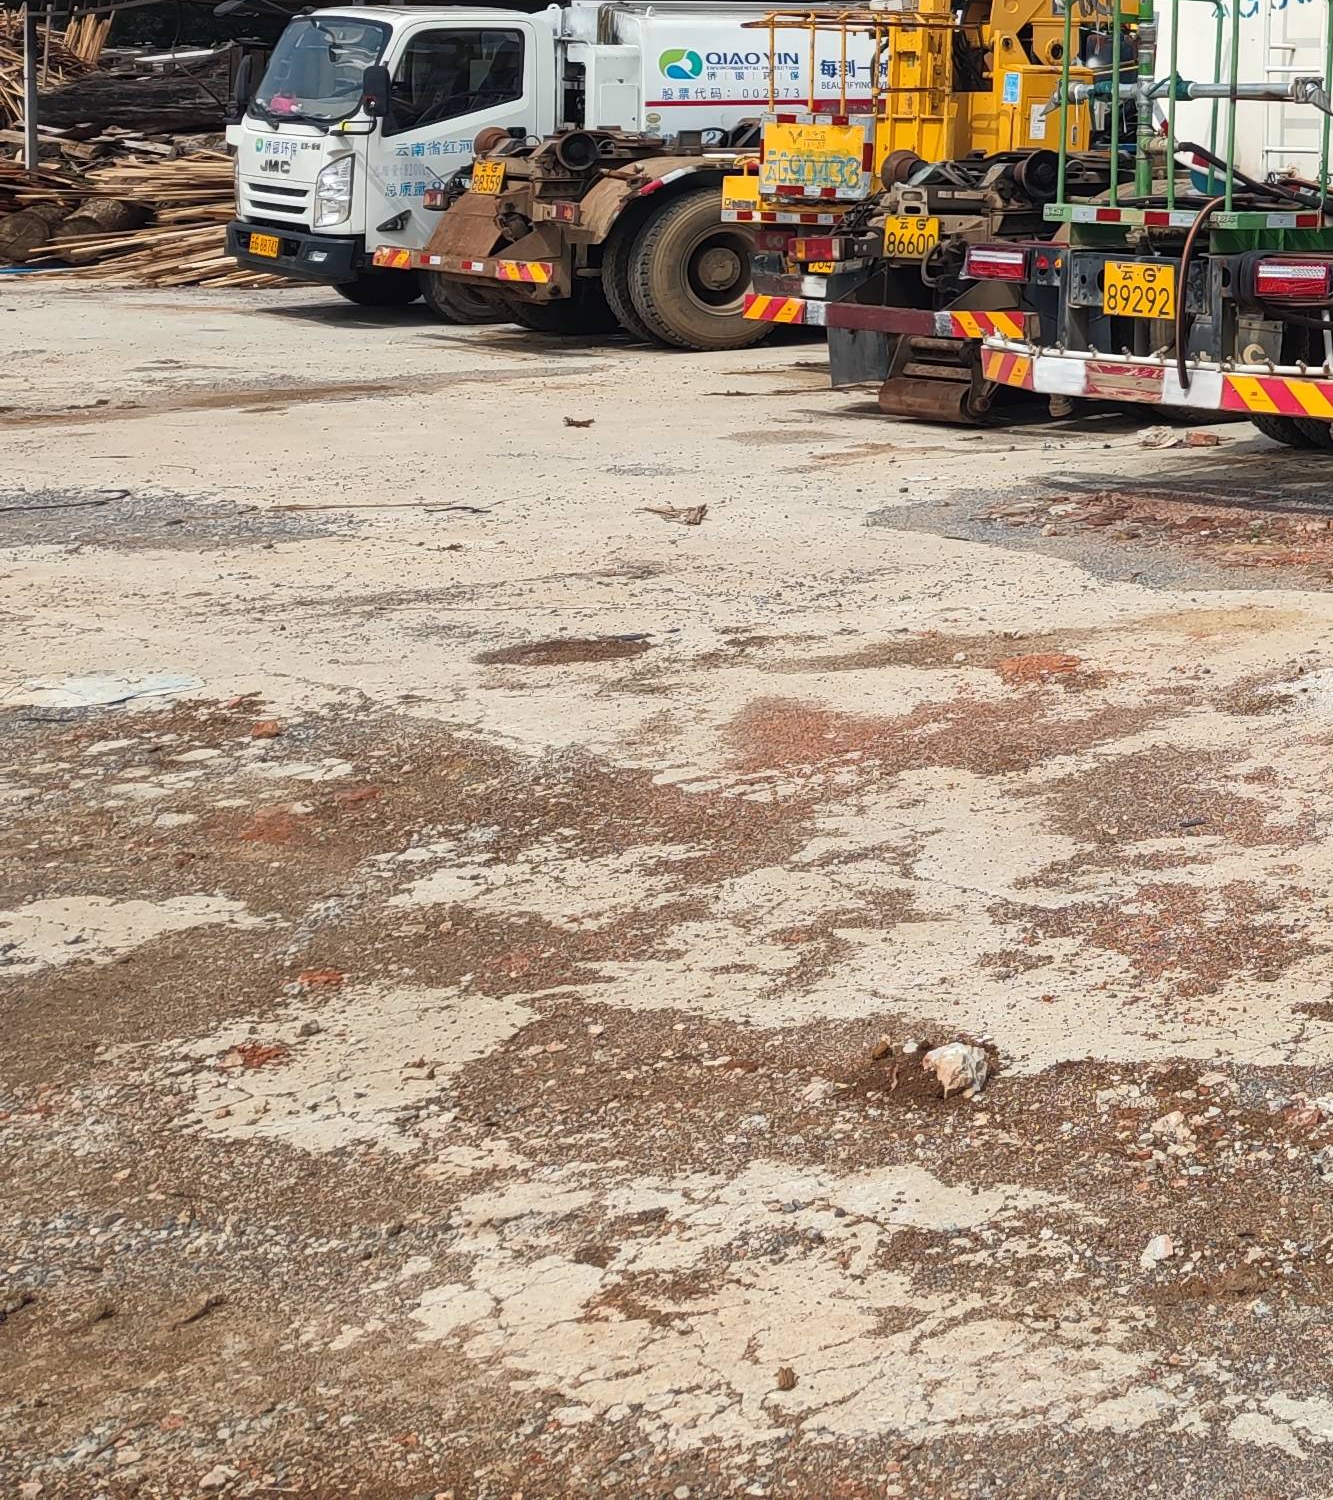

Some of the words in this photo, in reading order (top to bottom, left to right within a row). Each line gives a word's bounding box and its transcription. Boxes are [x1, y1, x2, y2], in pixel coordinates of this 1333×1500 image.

[260, 159, 290, 174] JMC
[887, 232, 935, 254] 86600
[1107, 284, 1170, 315] 89292
